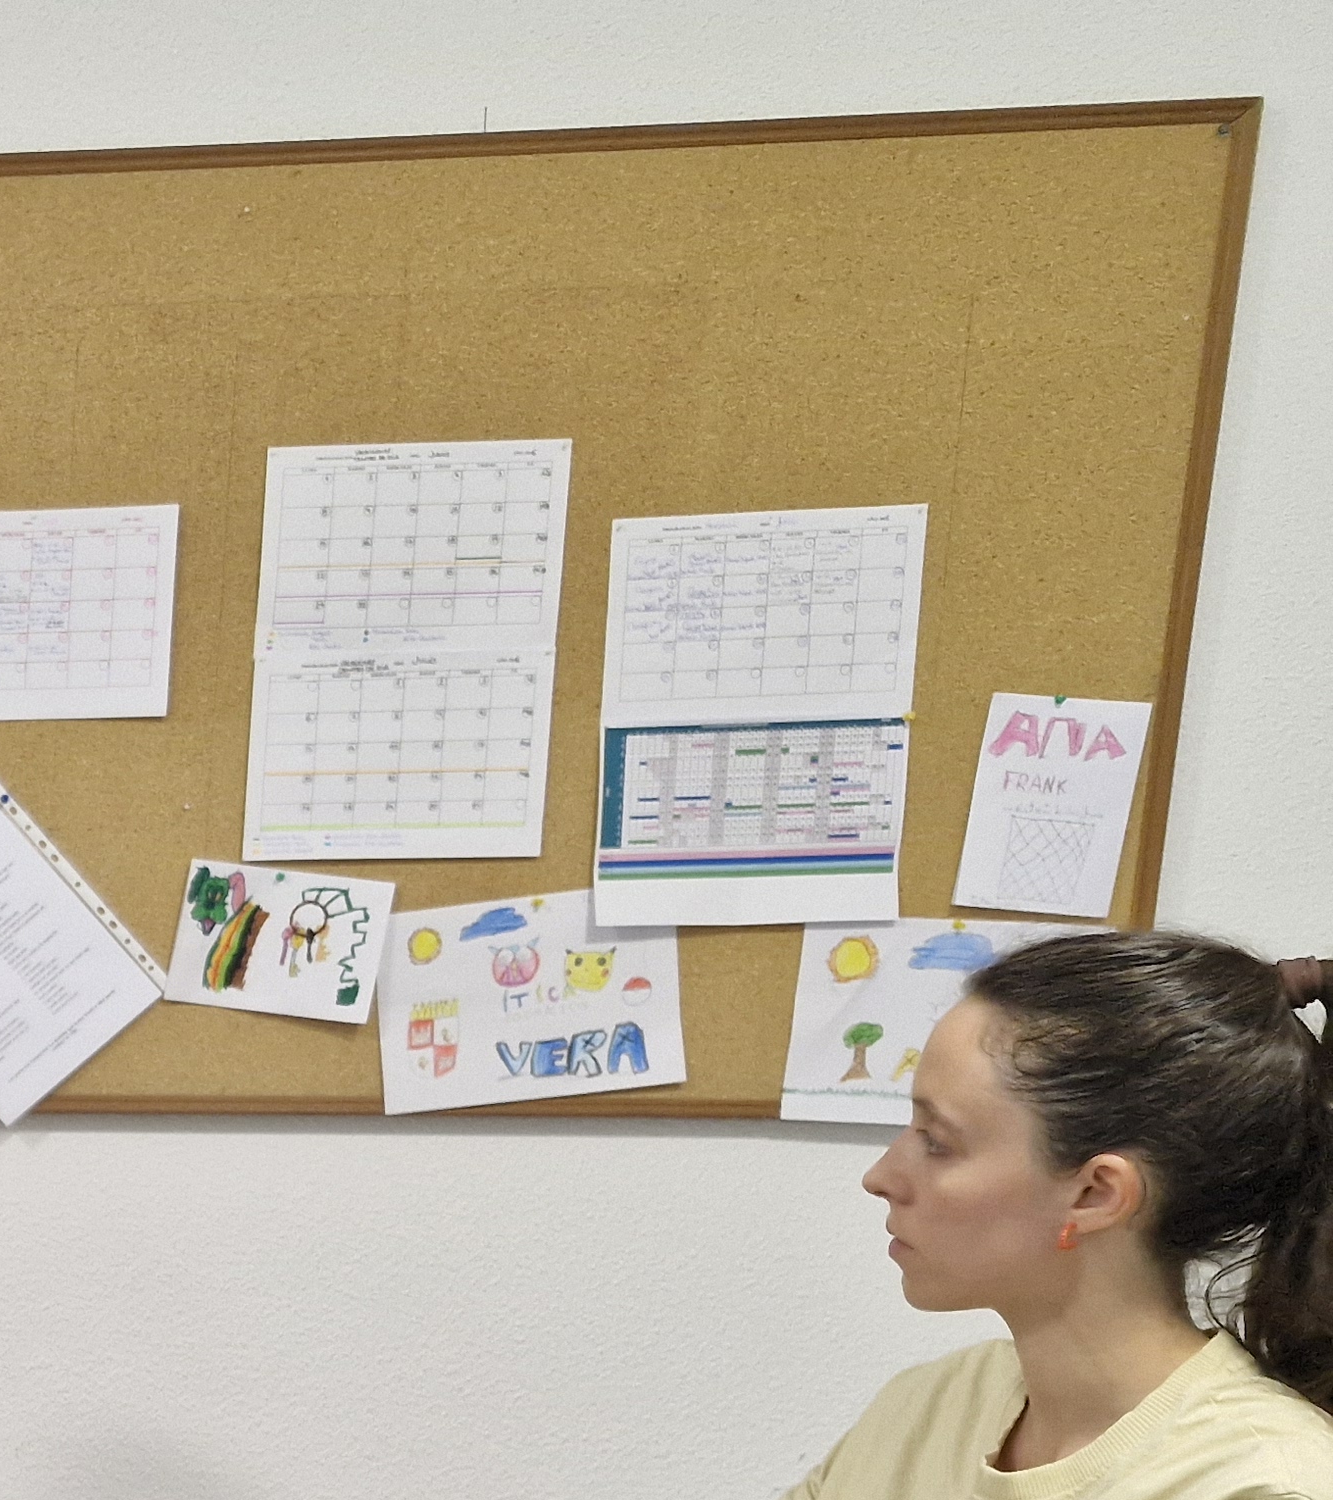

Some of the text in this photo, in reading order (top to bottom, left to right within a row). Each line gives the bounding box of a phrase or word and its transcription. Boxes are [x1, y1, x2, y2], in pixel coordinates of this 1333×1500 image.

[988, 711, 1126, 761] ANA
[1004, 770, 1067, 795] FRANK
[496, 1021, 650, 1078] VERA
